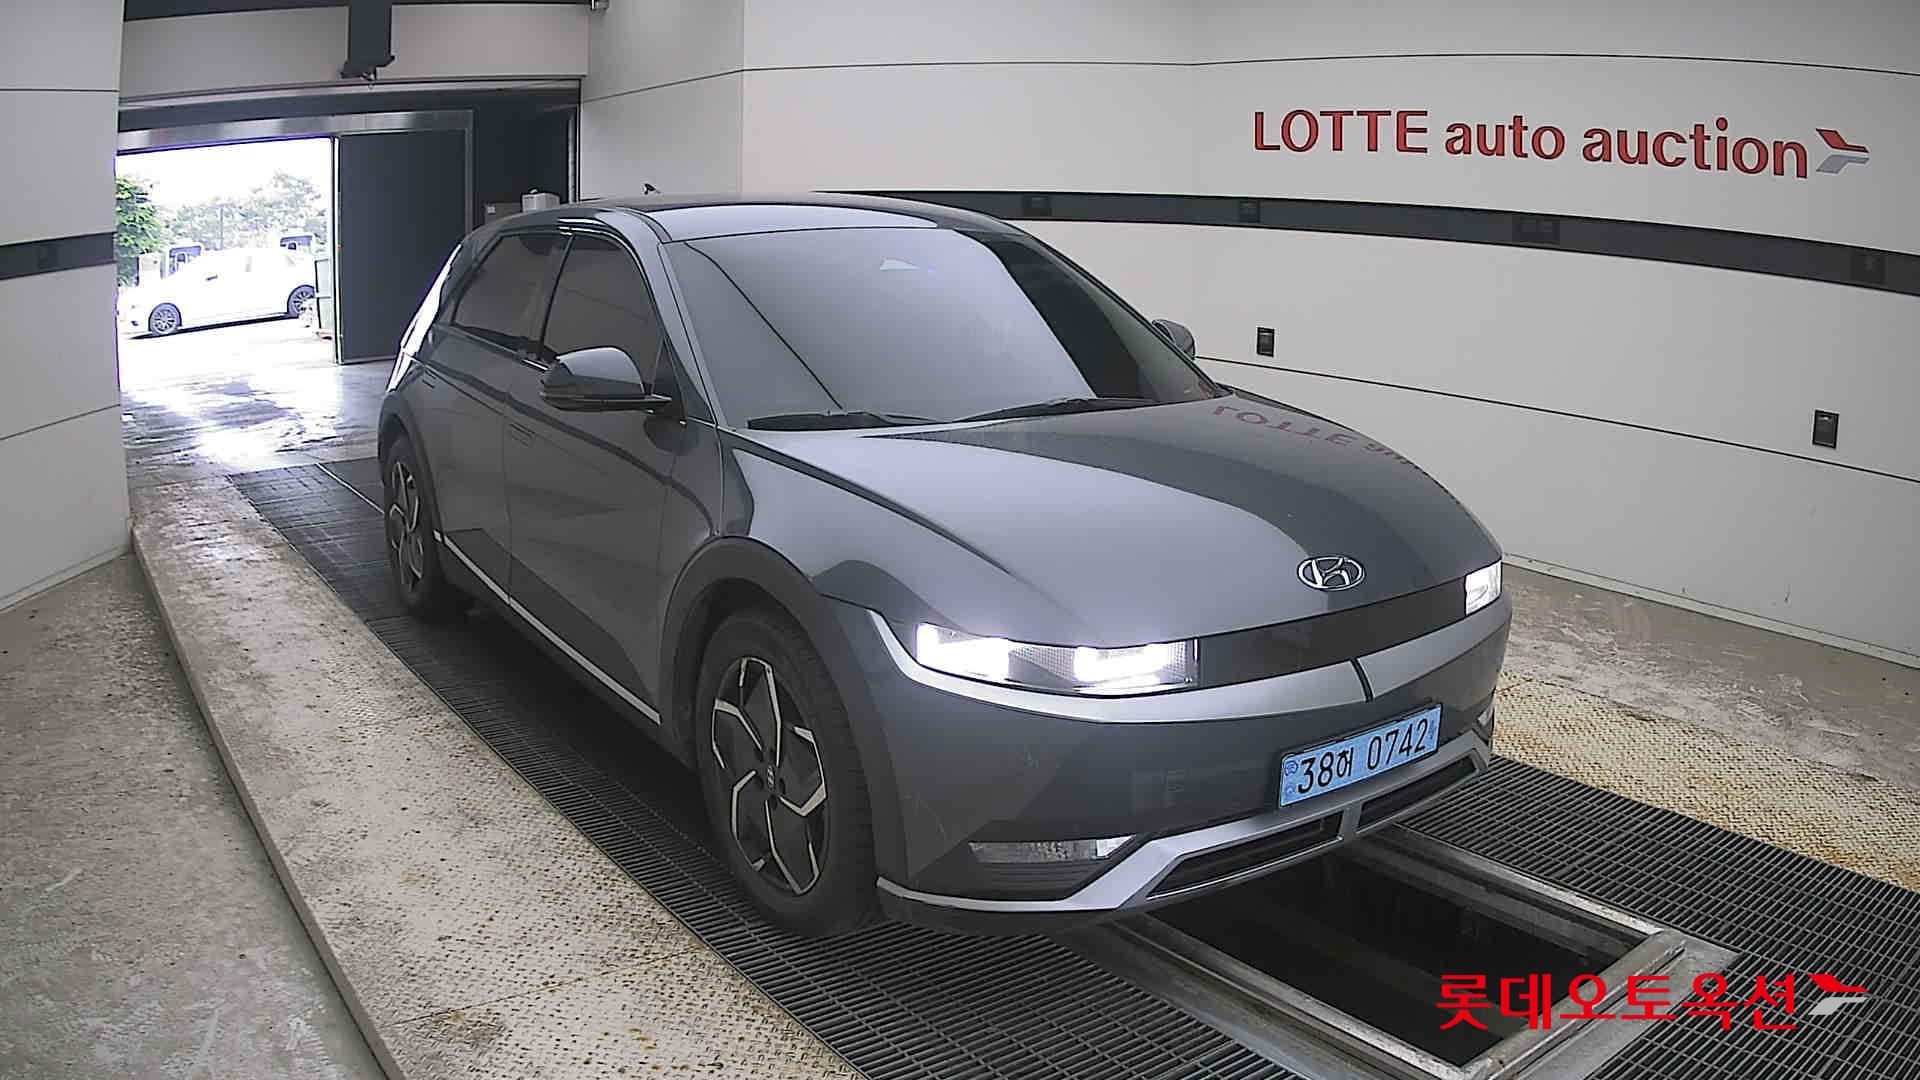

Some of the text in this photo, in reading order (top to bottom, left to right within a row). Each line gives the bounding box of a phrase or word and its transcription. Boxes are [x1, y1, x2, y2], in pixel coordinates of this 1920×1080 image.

[1254, 109, 1808, 179] LOTTE auto auction
[1298, 747, 1353, 794] 38허
[1367, 718, 1428, 770] 0742
